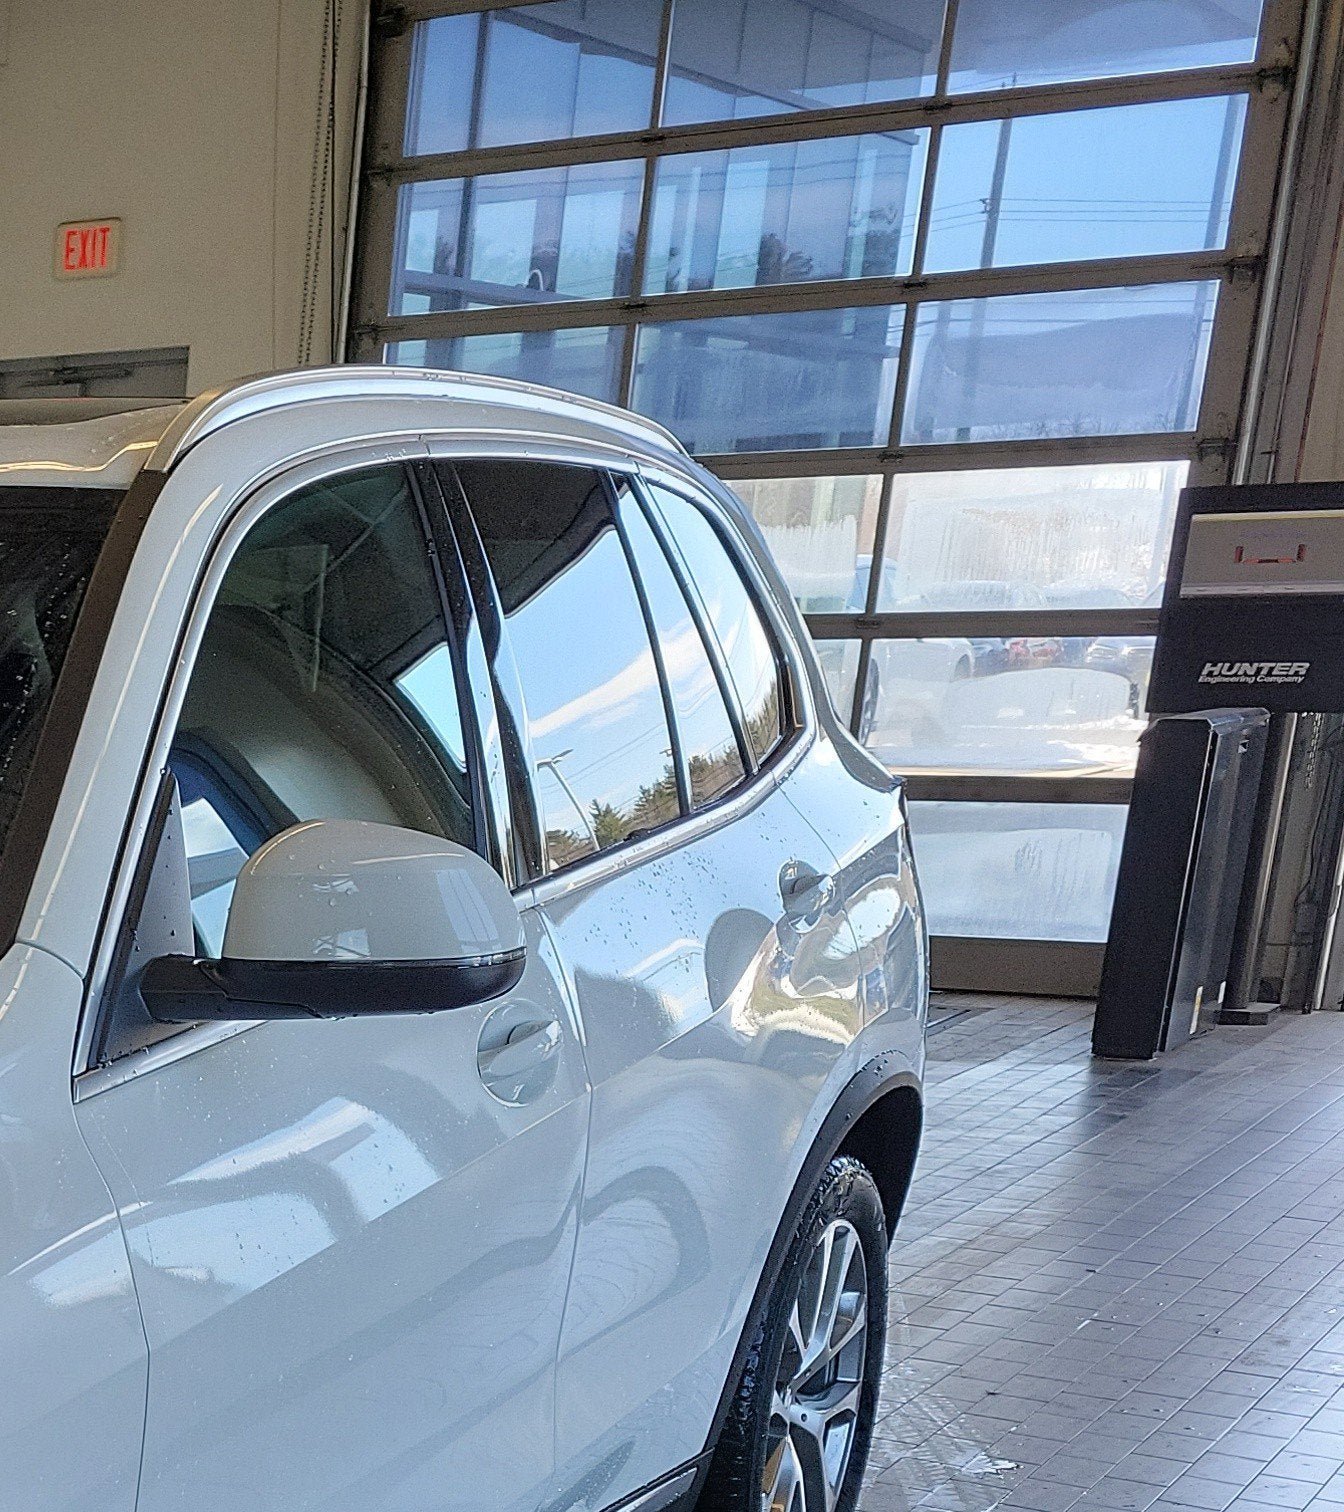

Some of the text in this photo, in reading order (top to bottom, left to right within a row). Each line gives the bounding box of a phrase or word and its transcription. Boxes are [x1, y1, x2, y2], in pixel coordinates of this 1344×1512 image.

[64, 227, 110, 271] EXIT
[1201, 662, 1310, 675] HUNTER
[1198, 675, 1305, 684] Engineering Company
